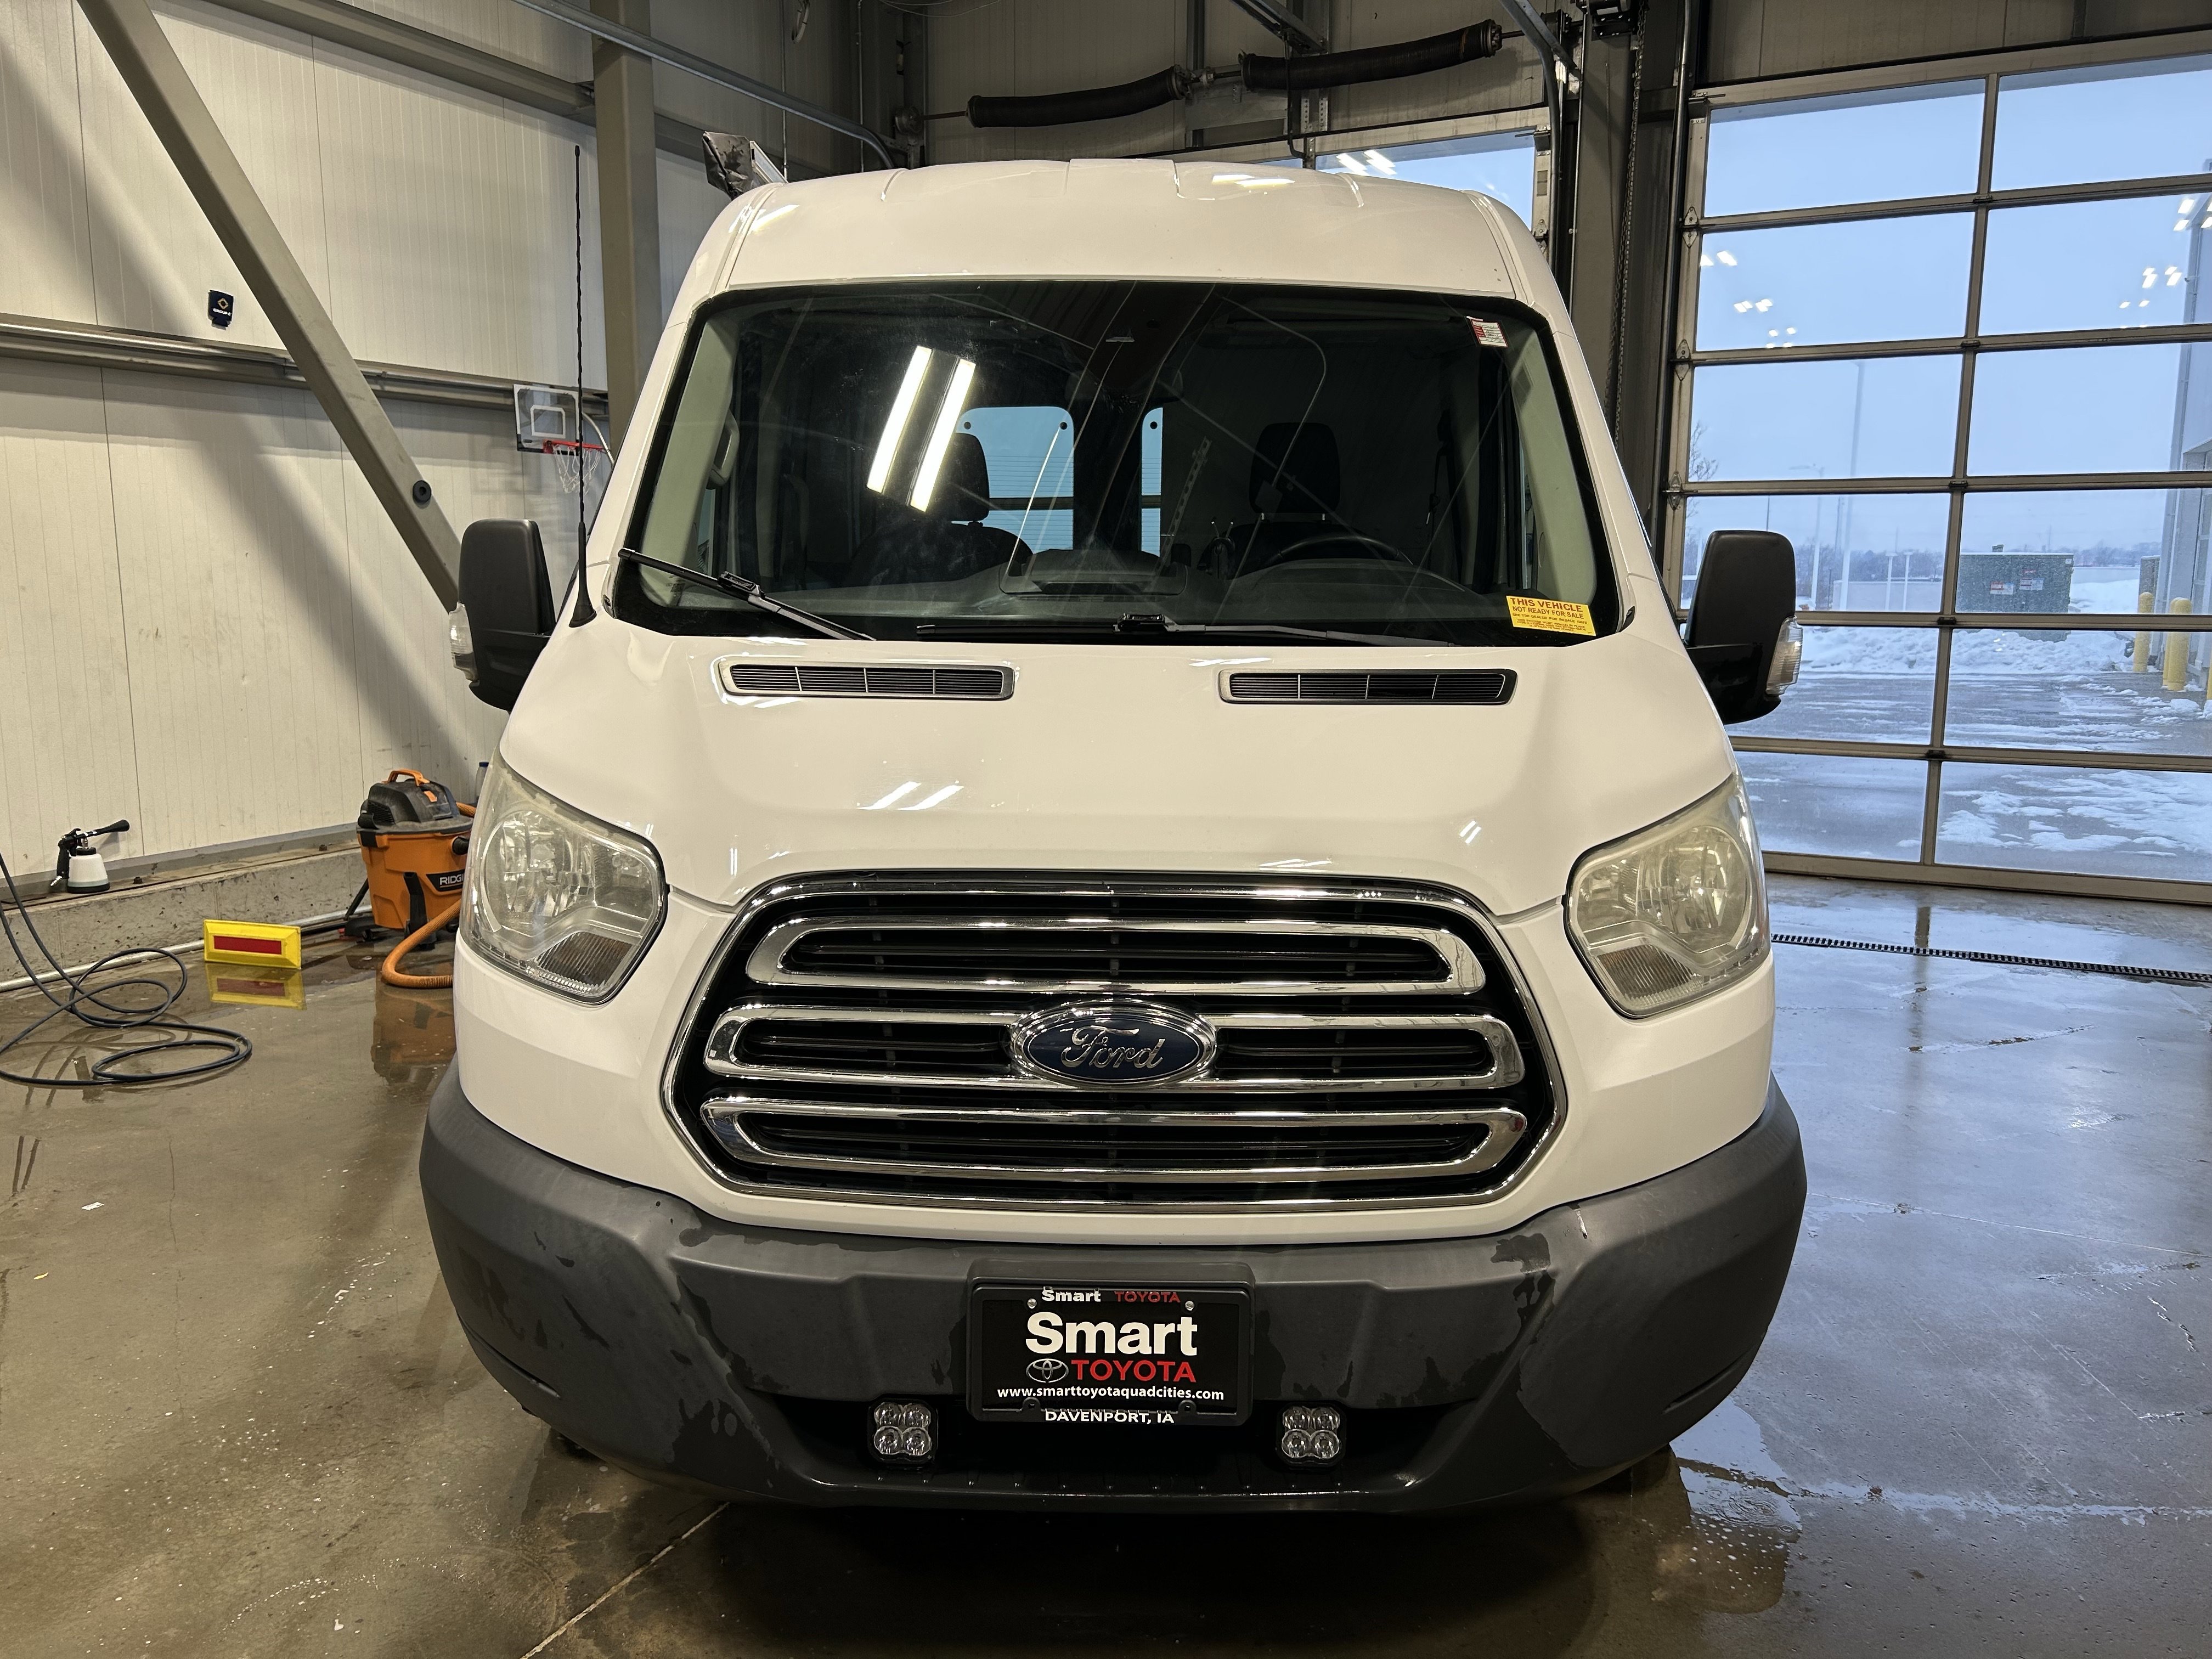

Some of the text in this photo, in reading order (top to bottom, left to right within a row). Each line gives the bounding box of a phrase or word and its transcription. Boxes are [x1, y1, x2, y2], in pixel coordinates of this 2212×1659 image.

[1510, 597, 1583, 613] THIS VEHICLE
[1060, 1025, 1166, 1069] Ford
[1042, 1289, 1181, 1304] Smart TOYOTA
[1025, 1311, 1198, 1356] Smart
[1071, 1359, 1197, 1383] TOYOTA
[997, 1385, 1224, 1400] www.smarttoyotaquadcities.com
[1045, 1410, 1175, 1425] DAVENPORT, IA
